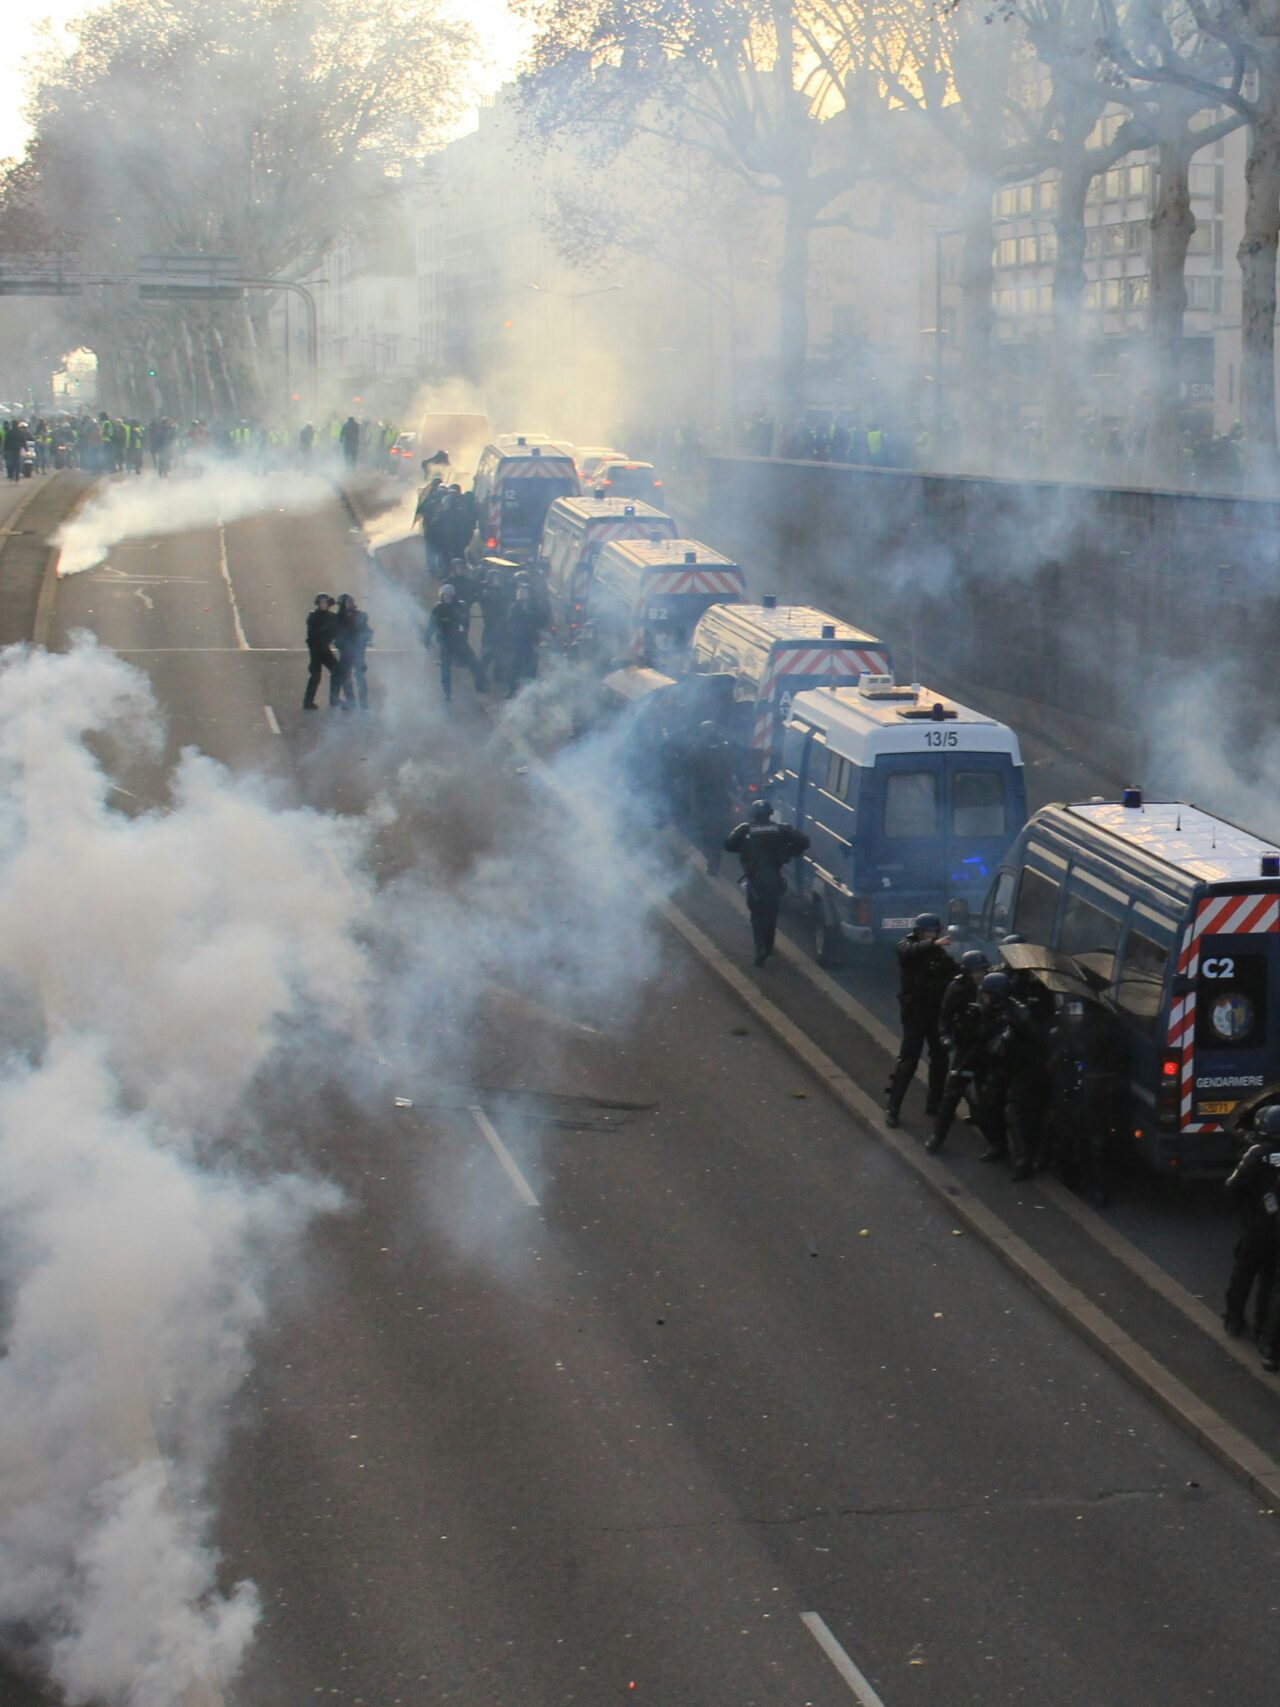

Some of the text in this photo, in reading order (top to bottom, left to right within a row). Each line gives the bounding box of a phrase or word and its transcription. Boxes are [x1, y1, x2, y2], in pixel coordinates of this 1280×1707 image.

[924, 731, 958, 747] 13/5
[1202, 958, 1235, 978] C2
[1197, 1075, 1264, 1088] GENDARMERIE
